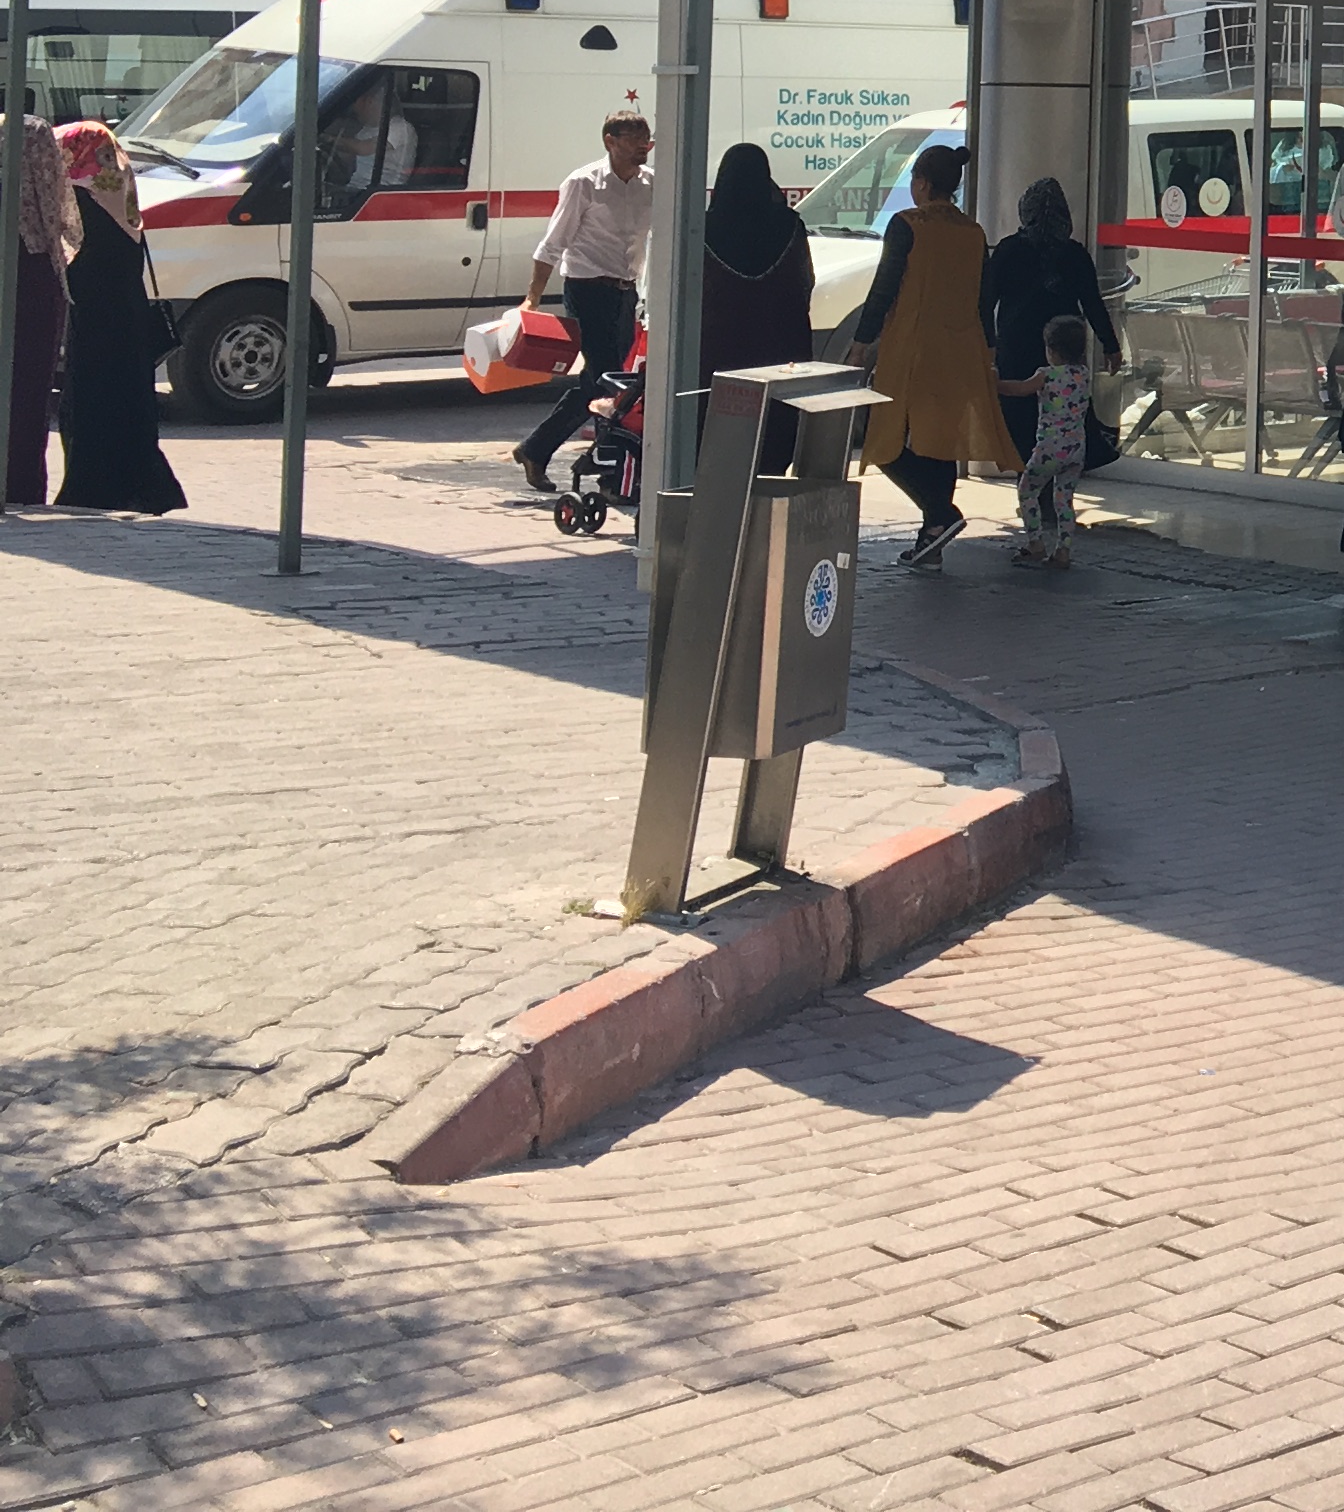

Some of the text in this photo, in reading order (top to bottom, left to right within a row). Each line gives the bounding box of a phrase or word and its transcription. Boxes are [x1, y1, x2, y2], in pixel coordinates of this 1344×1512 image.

[779, 88, 910, 106] Dr. Faruk Sükan
[776, 110, 825, 126] Kadın
[829, 110, 889, 130] Doğum
